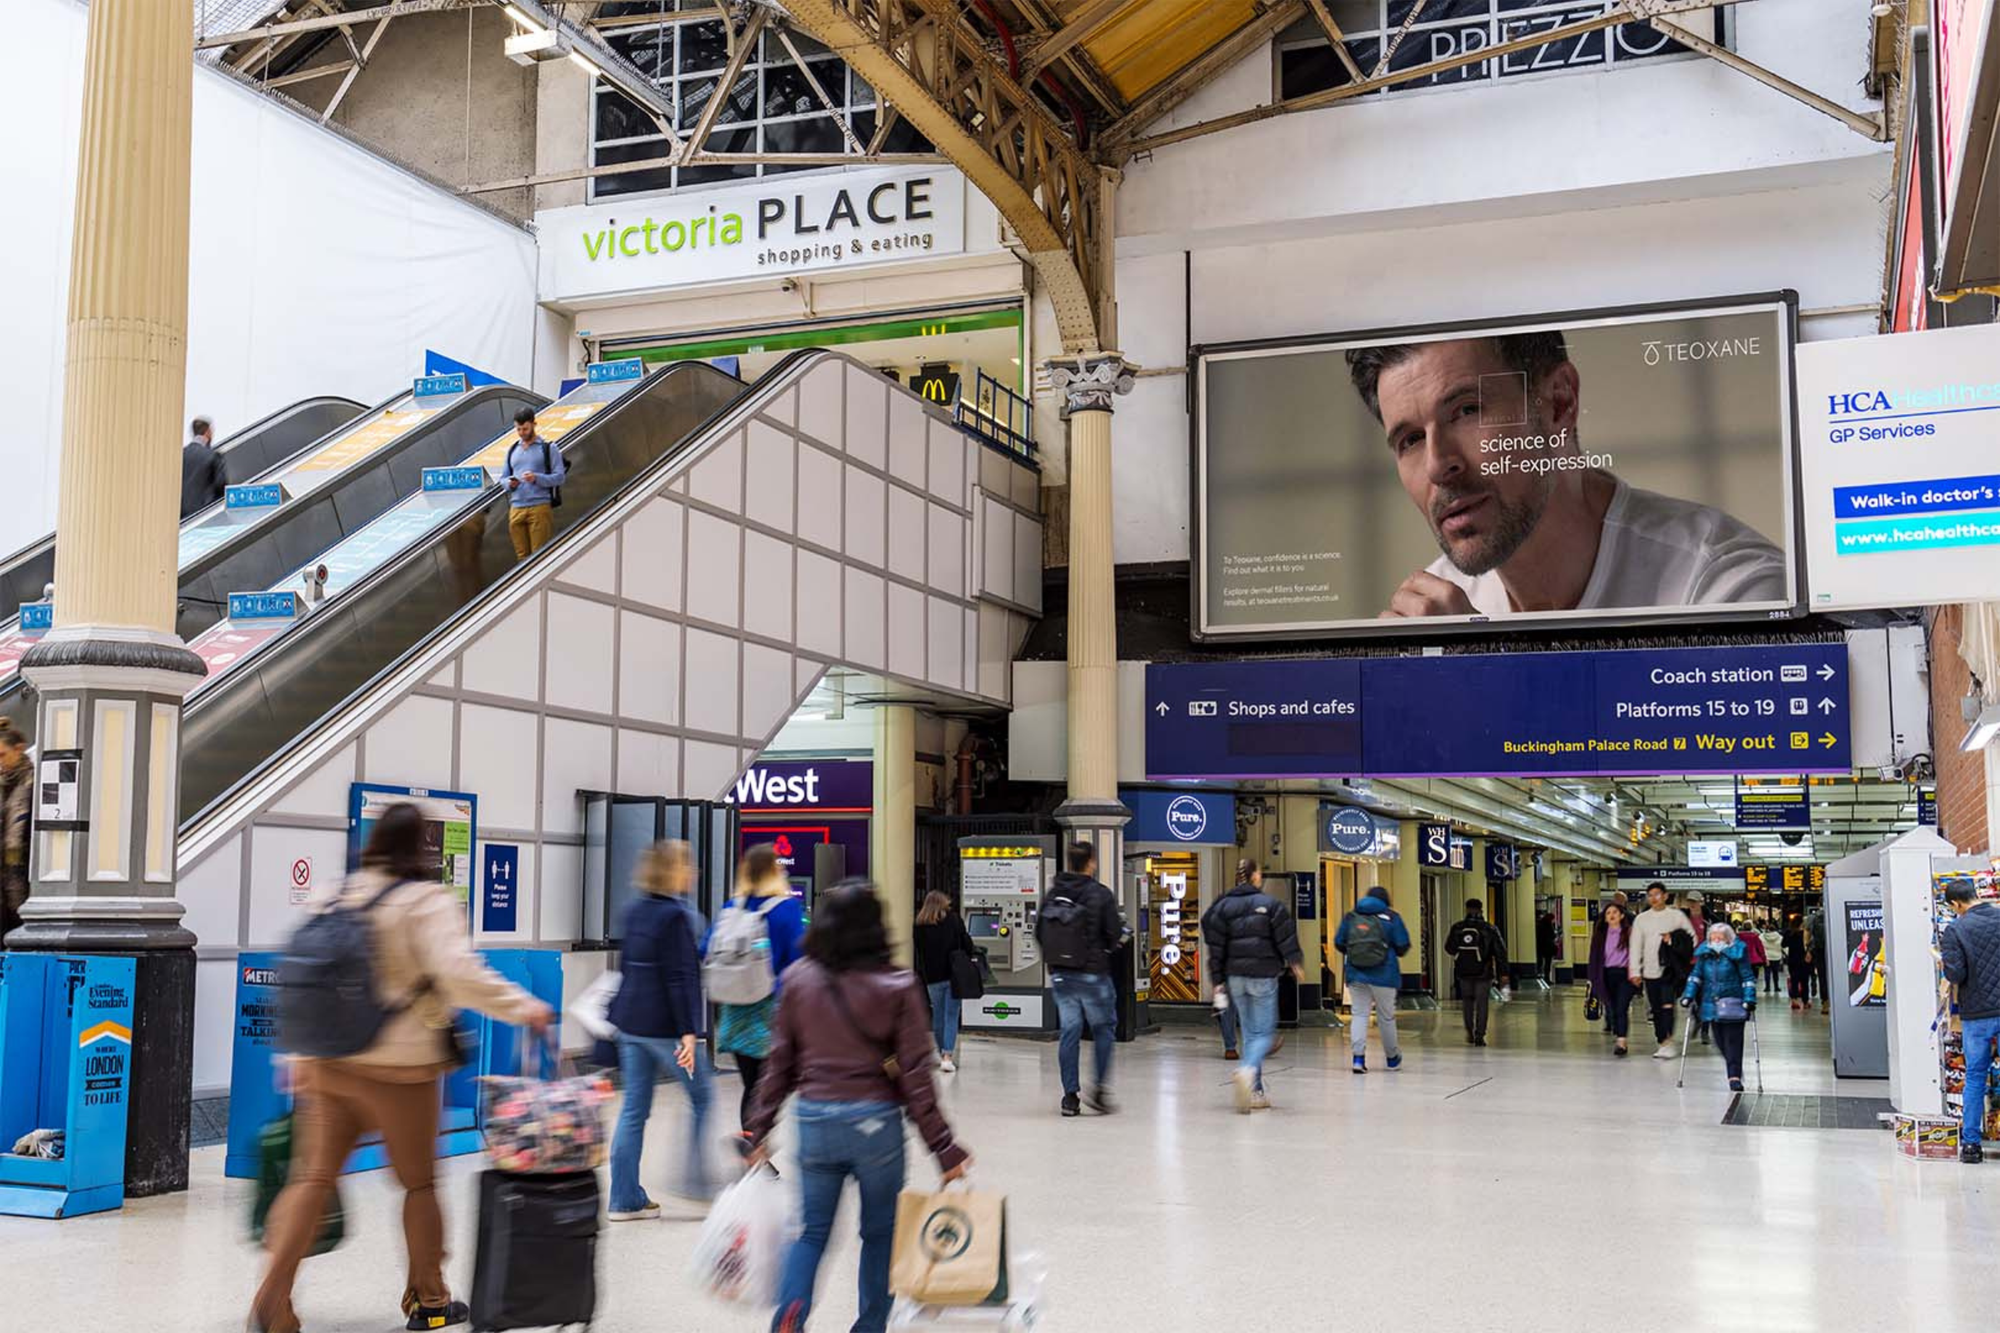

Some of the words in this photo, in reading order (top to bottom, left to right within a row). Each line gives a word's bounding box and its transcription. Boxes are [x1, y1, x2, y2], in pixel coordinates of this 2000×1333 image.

[582, 205, 742, 262] victoria
[758, 178, 933, 240] PLACE
[757, 243, 842, 265] shopping
[850, 240, 863, 253] &
[871, 231, 933, 251] eating
[1665, 337, 1760, 362] TEOXANE
[1828, 391, 1892, 415] HCA
[1480, 434, 1545, 453] science
[1549, 428, 1568, 448] of
[1829, 427, 1855, 443] GP
[1859, 423, 1935, 441] Services
[1480, 450, 1613, 476] self-expression
[1851, 491, 1917, 510] Walk-in
[1922, 486, 1993, 504] doctor's
[1264, 553, 1301, 562] confidence
[1224, 567, 1239, 575] Find
[1252, 565, 1269, 573] what
[1650, 668, 1706, 684] Coach
[1711, 666, 1773, 682] station
[1228, 701, 1276, 717] Shops
[1280, 700, 1309, 715] and
[1313, 699, 1355, 714] cafes
[1616, 701, 1701, 718] Platforms
[1706, 701, 1726, 716] 15
[1731, 701, 1750, 715] to
[1755, 699, 1775, 715] 19
[1503, 739, 1585, 755] Buckingham
[1588, 738, 1630, 752] Palace
[1634, 738, 1667, 750] Road
[1696, 734, 1736, 753] Way
[1742, 734, 1775, 749] out
[54, 808, 61, 819] 2
[1171, 811, 1202, 822] Pure.
[1332, 823, 1371, 834] Pure.
[1160, 872, 1187, 975] Pure.
[89, 986, 125, 999] Evening
[89, 997, 129, 1009] Standard
[86, 1055, 124, 1077] LONDON
[85, 1093, 98, 1106] TO
[99, 1091, 122, 1105] LIFE
